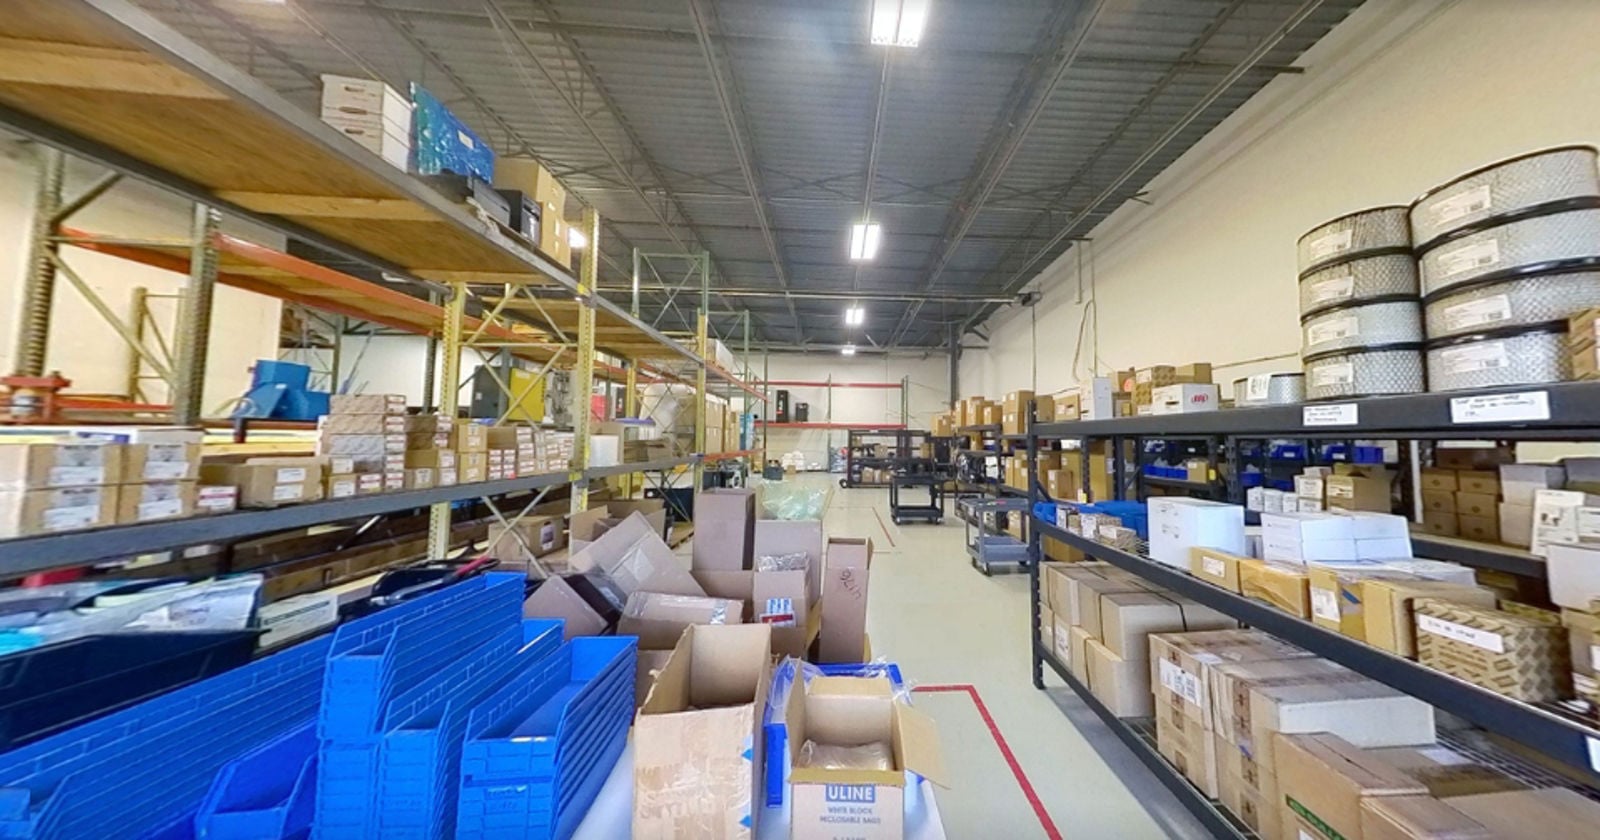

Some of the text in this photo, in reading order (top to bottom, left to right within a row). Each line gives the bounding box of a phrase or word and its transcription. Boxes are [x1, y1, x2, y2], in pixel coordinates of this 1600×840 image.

[828, 785, 873, 801] ULINE
[828, 806, 873, 815] WHITE BLOCK
[819, 815, 881, 825] RECLOSABLE BAGS
